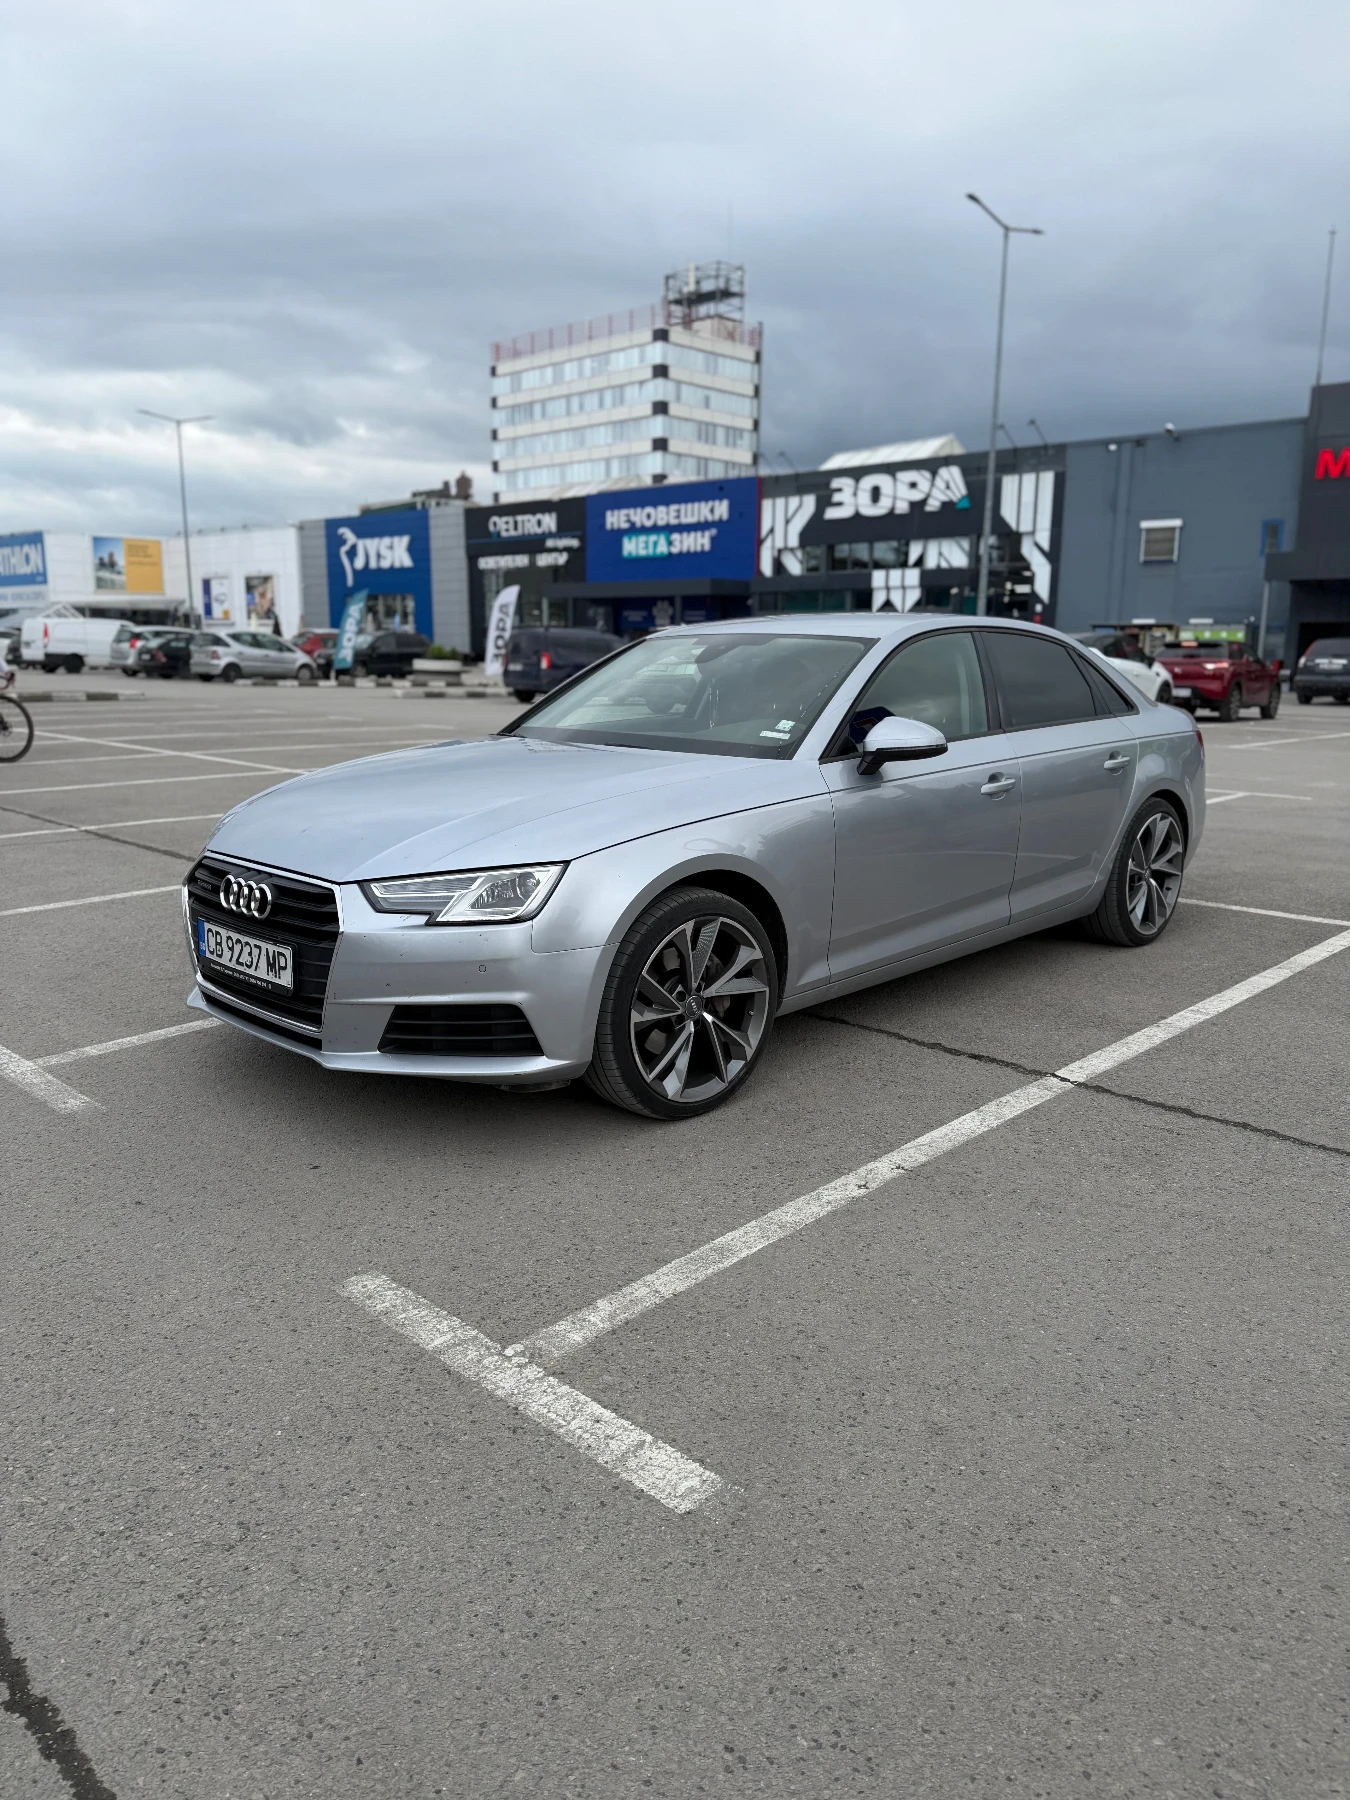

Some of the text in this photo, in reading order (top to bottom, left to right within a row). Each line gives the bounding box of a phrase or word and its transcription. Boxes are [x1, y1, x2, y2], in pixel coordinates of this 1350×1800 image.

[605, 498, 730, 531] НЕЧОВЕШКИ
[823, 465, 971, 520] ЗОРА
[353, 534, 414, 571] JYSK
[206, 927, 224, 959] CB
[226, 935, 263, 972] 9237
[265, 947, 288, 980] MP
